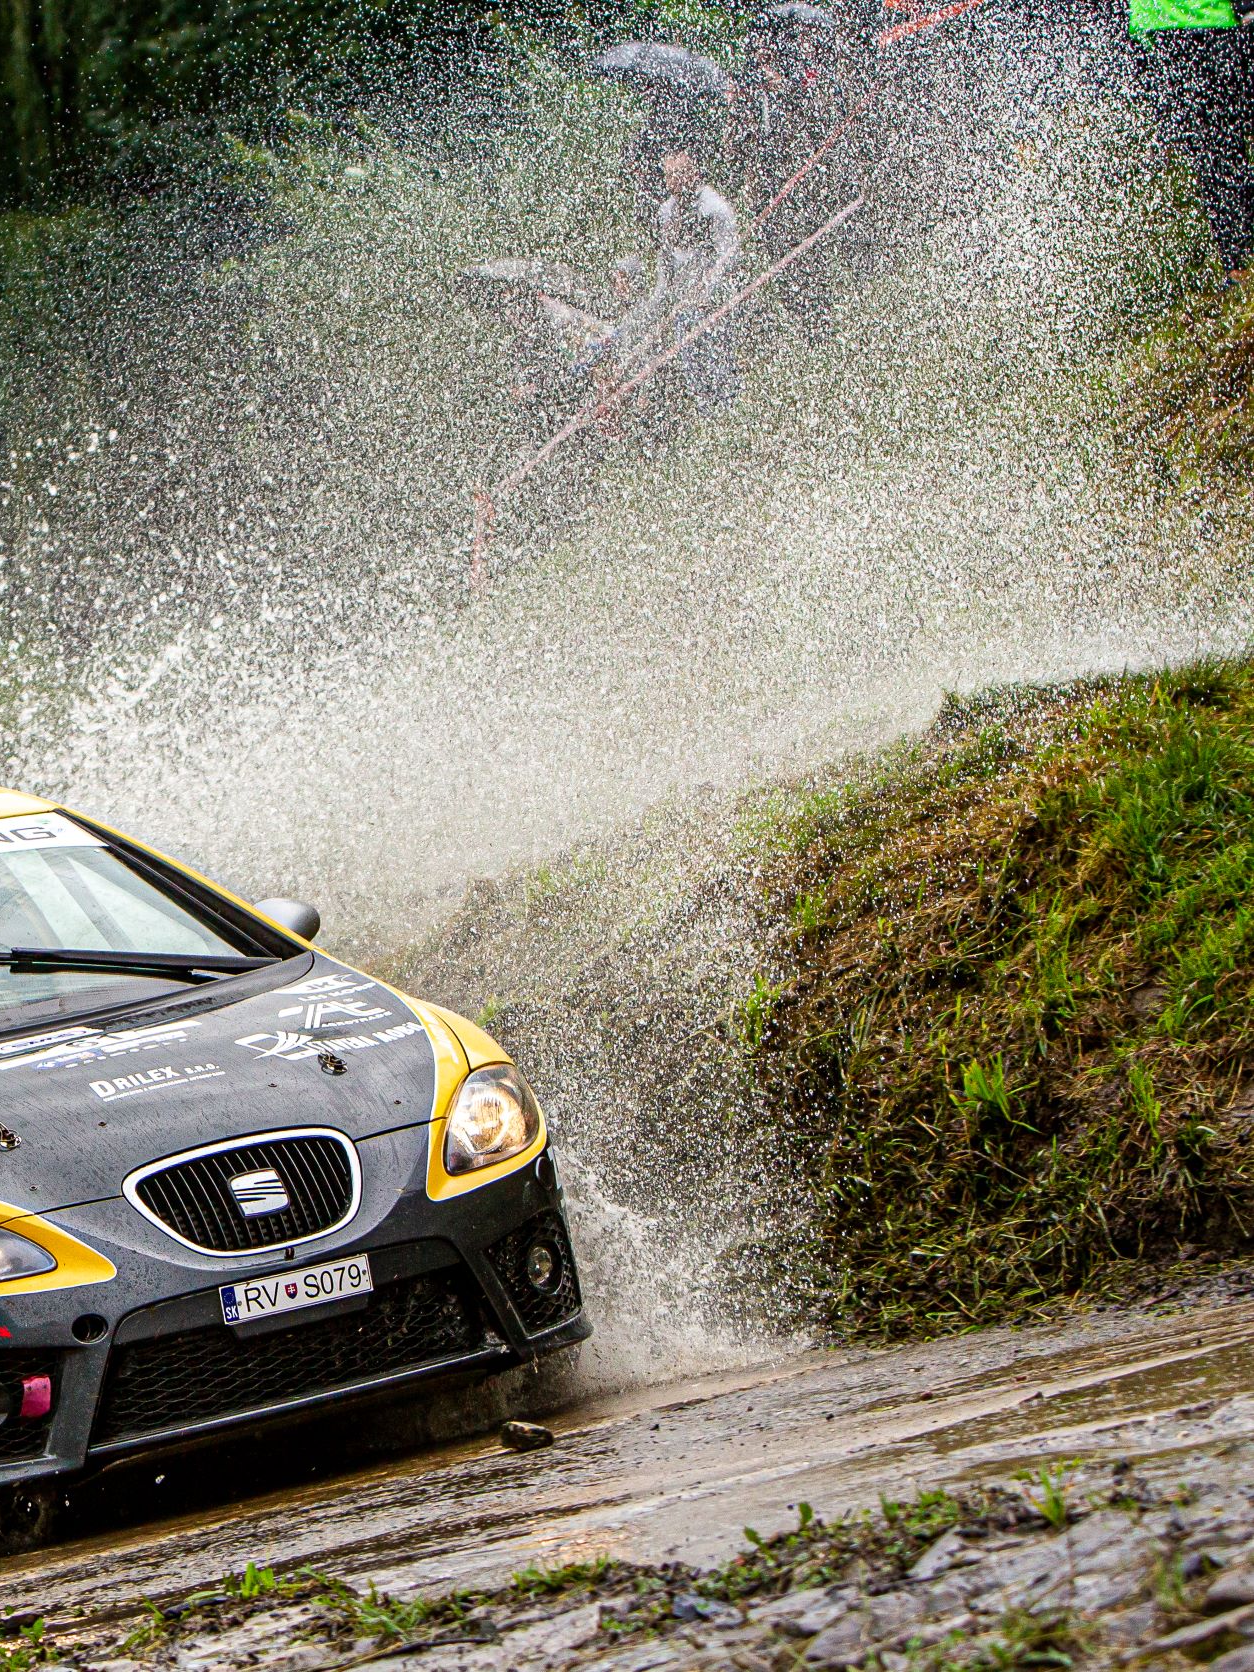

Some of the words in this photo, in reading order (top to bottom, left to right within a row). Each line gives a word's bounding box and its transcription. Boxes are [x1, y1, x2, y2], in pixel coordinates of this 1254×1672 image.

[89, 1066, 181, 1098] DRILEX
[244, 1282, 280, 1312] RV
[303, 1263, 362, 1299] S079
[225, 1305, 238, 1319] SK
